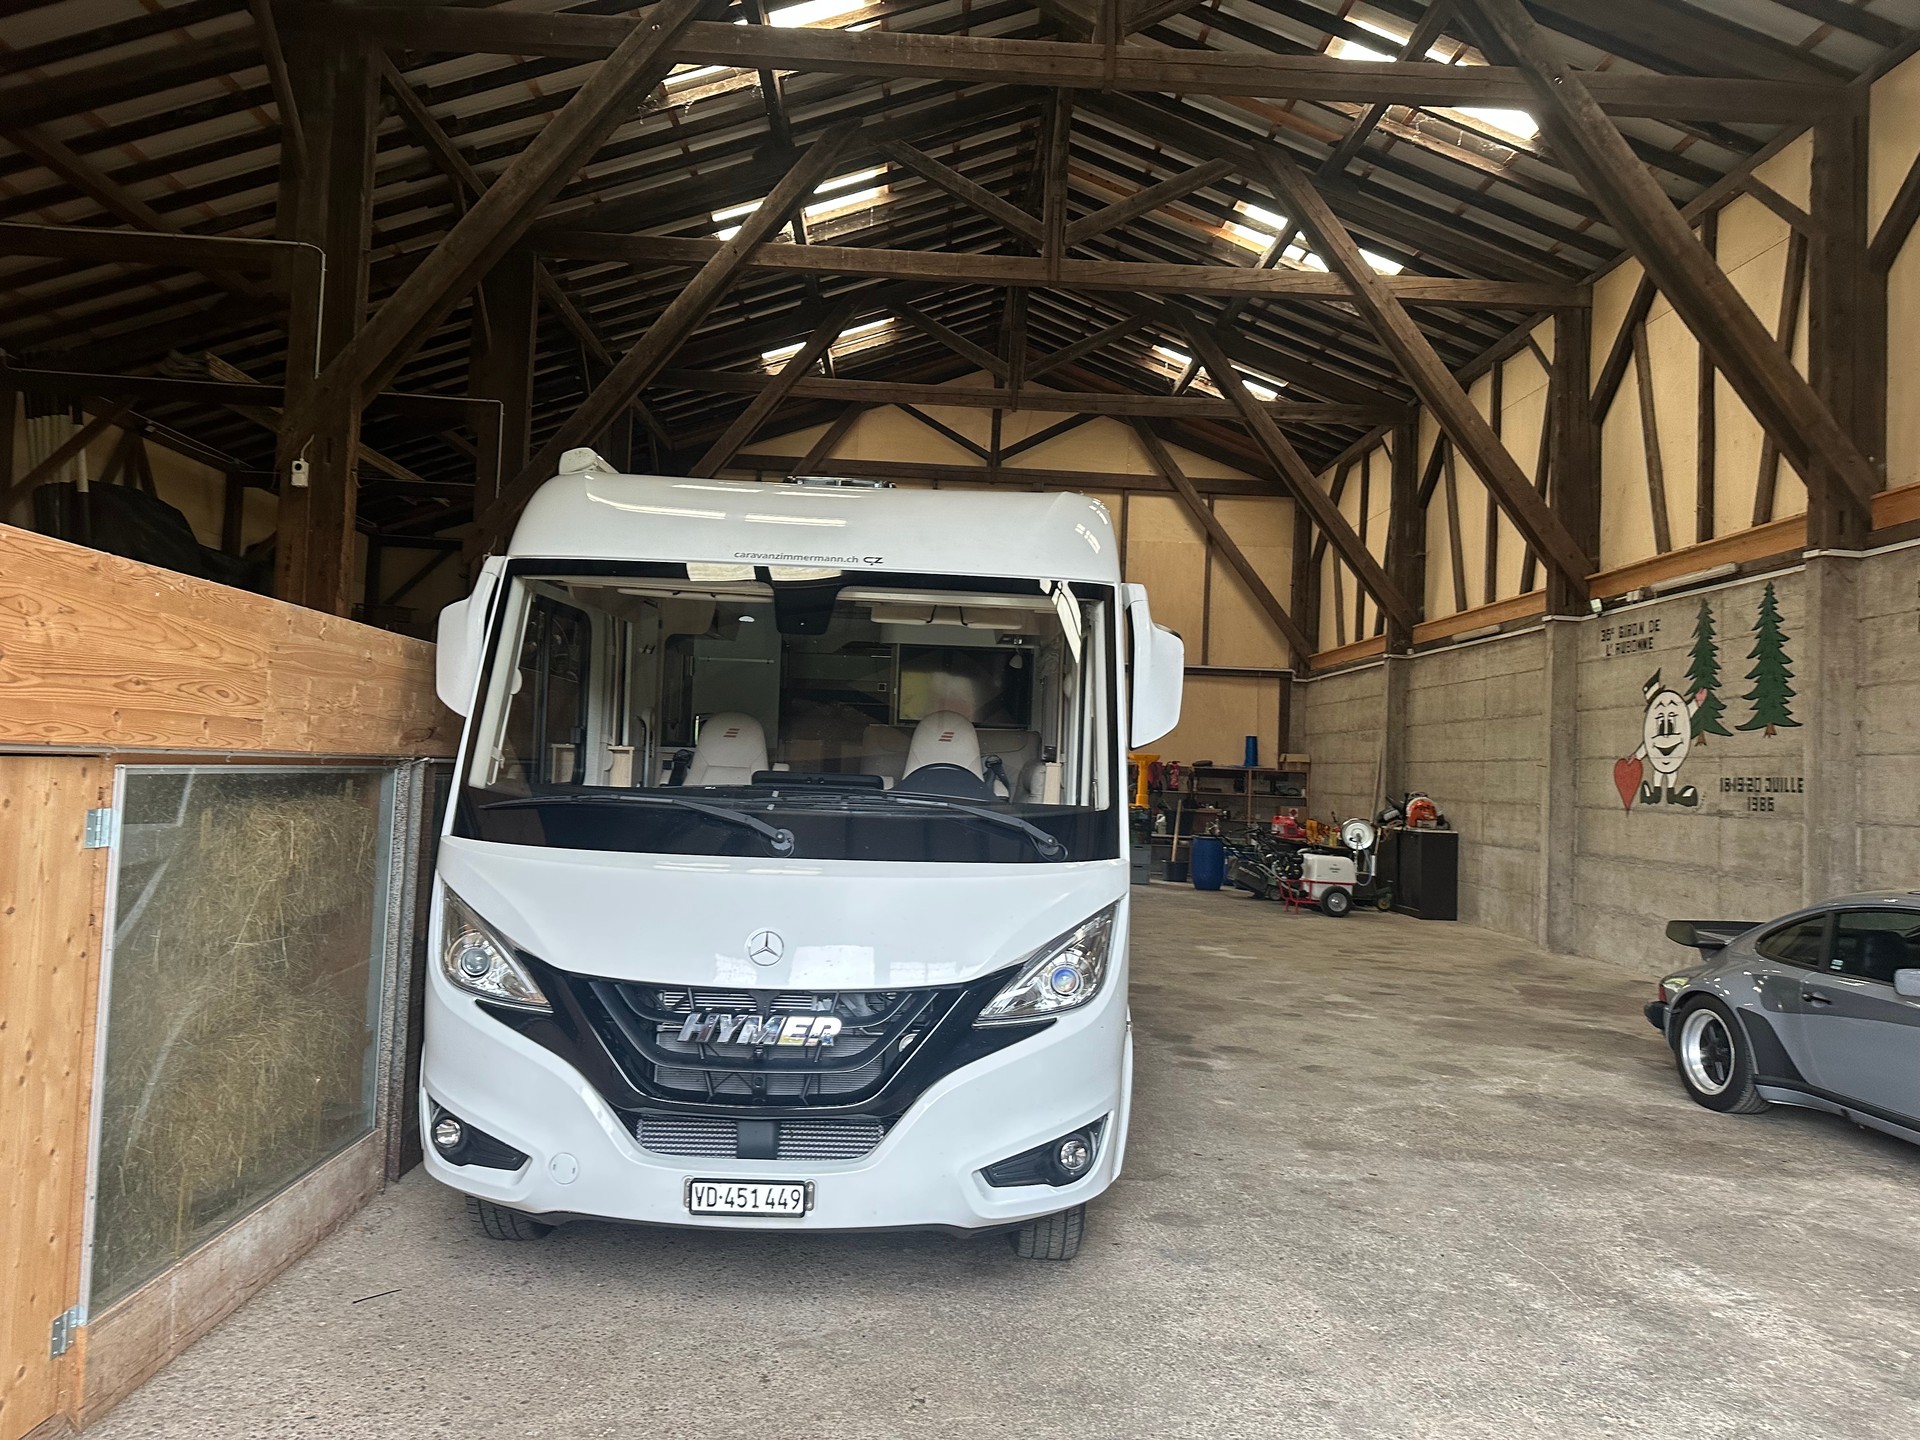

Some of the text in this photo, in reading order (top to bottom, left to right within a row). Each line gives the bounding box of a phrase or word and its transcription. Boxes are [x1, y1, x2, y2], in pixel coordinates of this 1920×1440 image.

[734, 551, 859, 563] caravanzimmermann.ch
[1649, 618, 1661, 633] DE
[1765, 777, 1804, 793] JUILLE
[676, 1013, 843, 1047] HYMER
